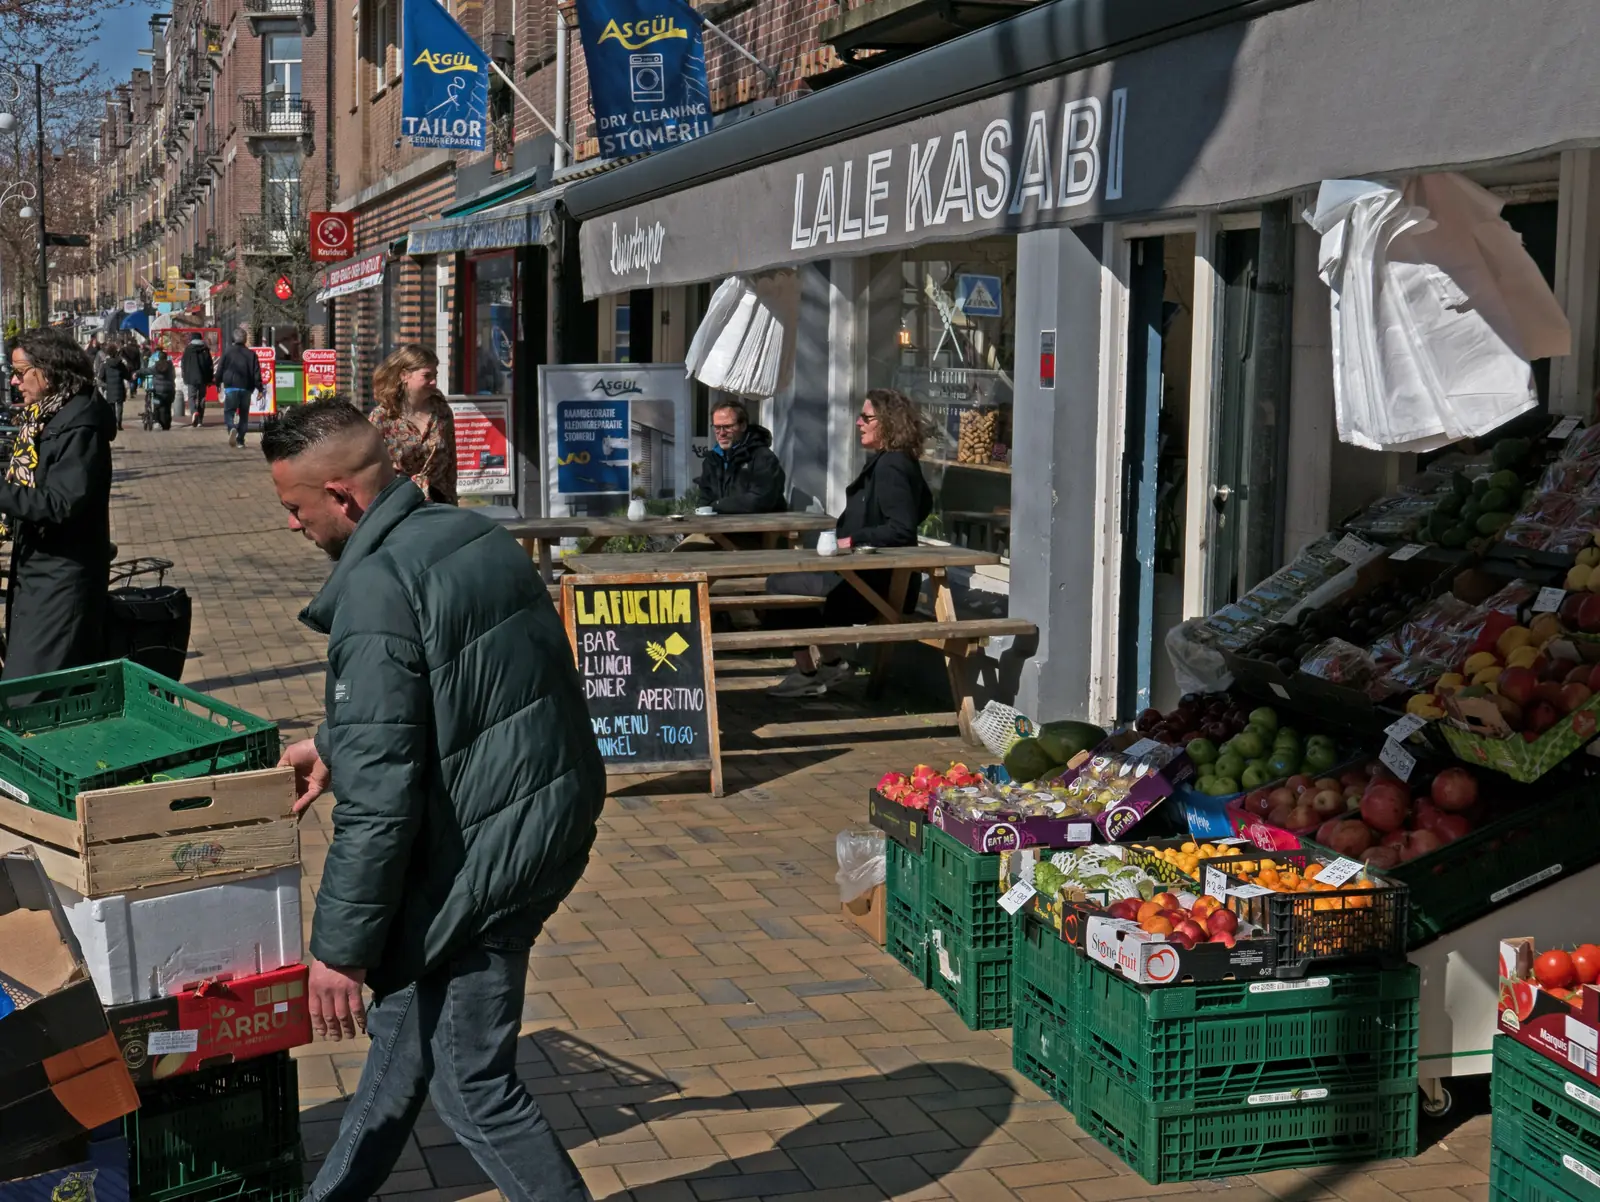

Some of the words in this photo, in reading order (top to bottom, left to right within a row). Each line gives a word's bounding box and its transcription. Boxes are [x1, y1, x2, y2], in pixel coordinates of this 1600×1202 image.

[405, 116, 482, 138] TAILOR
[600, 113, 628, 130] DRY
[632, 103, 706, 124] CLEANING
[790, 148, 893, 251] LALE
[905, 86, 1128, 233] KASABI
[317, 247, 348, 257] Kruidvat
[609, 215, 666, 285] Buurtsuper
[256, 349, 272, 358] idvat
[310, 351, 335, 360] Kruidvat
[308, 363, 335, 374] ACTIE!
[592, 378, 643, 397] ASGÜL
[564, 408, 616, 418] RAAMDECORATIE
[564, 419, 623, 430] KLEDINGREPARATIE
[564, 431, 596, 442] STOMERIJ
[637, 687, 705, 712] APERITIVO
[614, 714, 649, 735] MENU
[597, 735, 637, 757] INKEL
[1110, 821, 1124, 837] EAT
[1122, 810, 1135, 824] ME
[987, 836, 1003, 848] EAT
[1003, 833, 1015, 845] ME
[1091, 932, 1118, 959] Stone
[1117, 946, 1137, 973] fruit
[198, 1002, 304, 1045] CARRUS
[1540, 1027, 1567, 1052] Marquis
